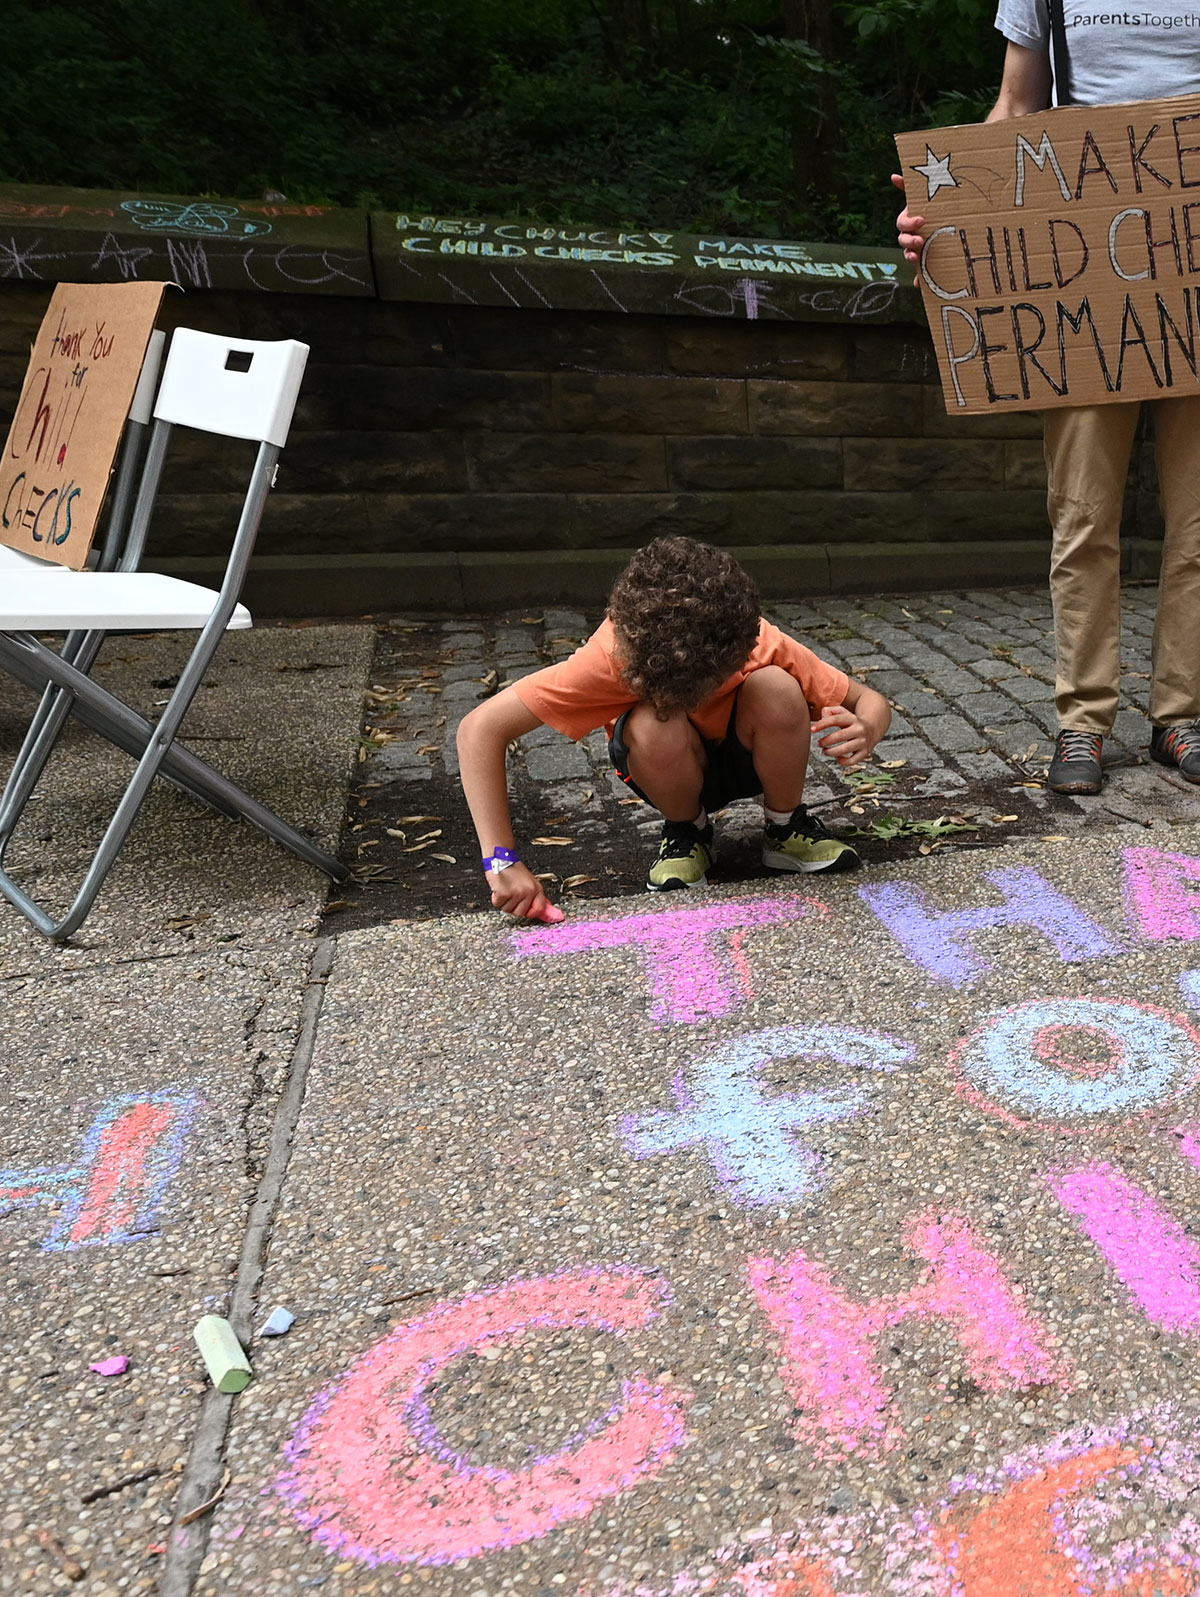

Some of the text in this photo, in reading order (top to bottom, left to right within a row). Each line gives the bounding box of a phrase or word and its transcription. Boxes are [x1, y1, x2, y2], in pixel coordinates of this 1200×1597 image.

[401, 237, 527, 258] CHILD
[534, 246, 677, 266] CHECKS
[698, 238, 811, 260] MAKE
[920, 219, 1090, 300] CHILD
